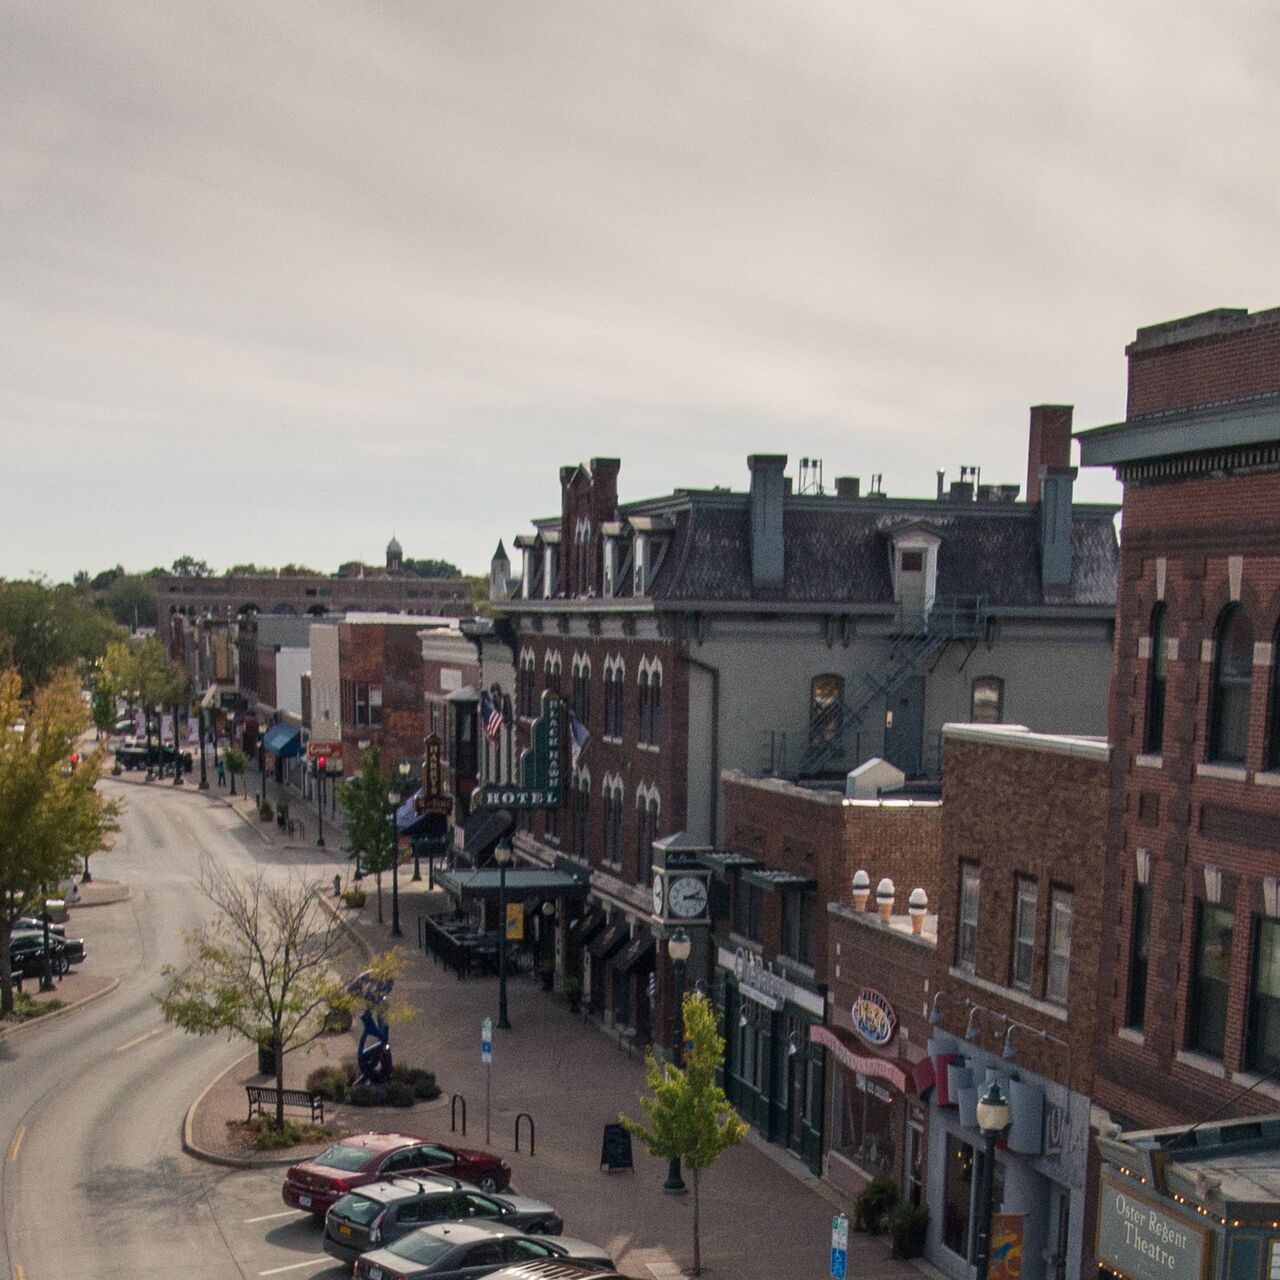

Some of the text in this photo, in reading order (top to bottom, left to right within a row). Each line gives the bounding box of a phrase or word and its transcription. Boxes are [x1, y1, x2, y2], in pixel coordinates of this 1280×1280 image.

[486, 791, 558, 805] HOTEL
[1115, 1193, 1188, 1250] Oster Regent
[1123, 1220, 1177, 1270] Theatre
